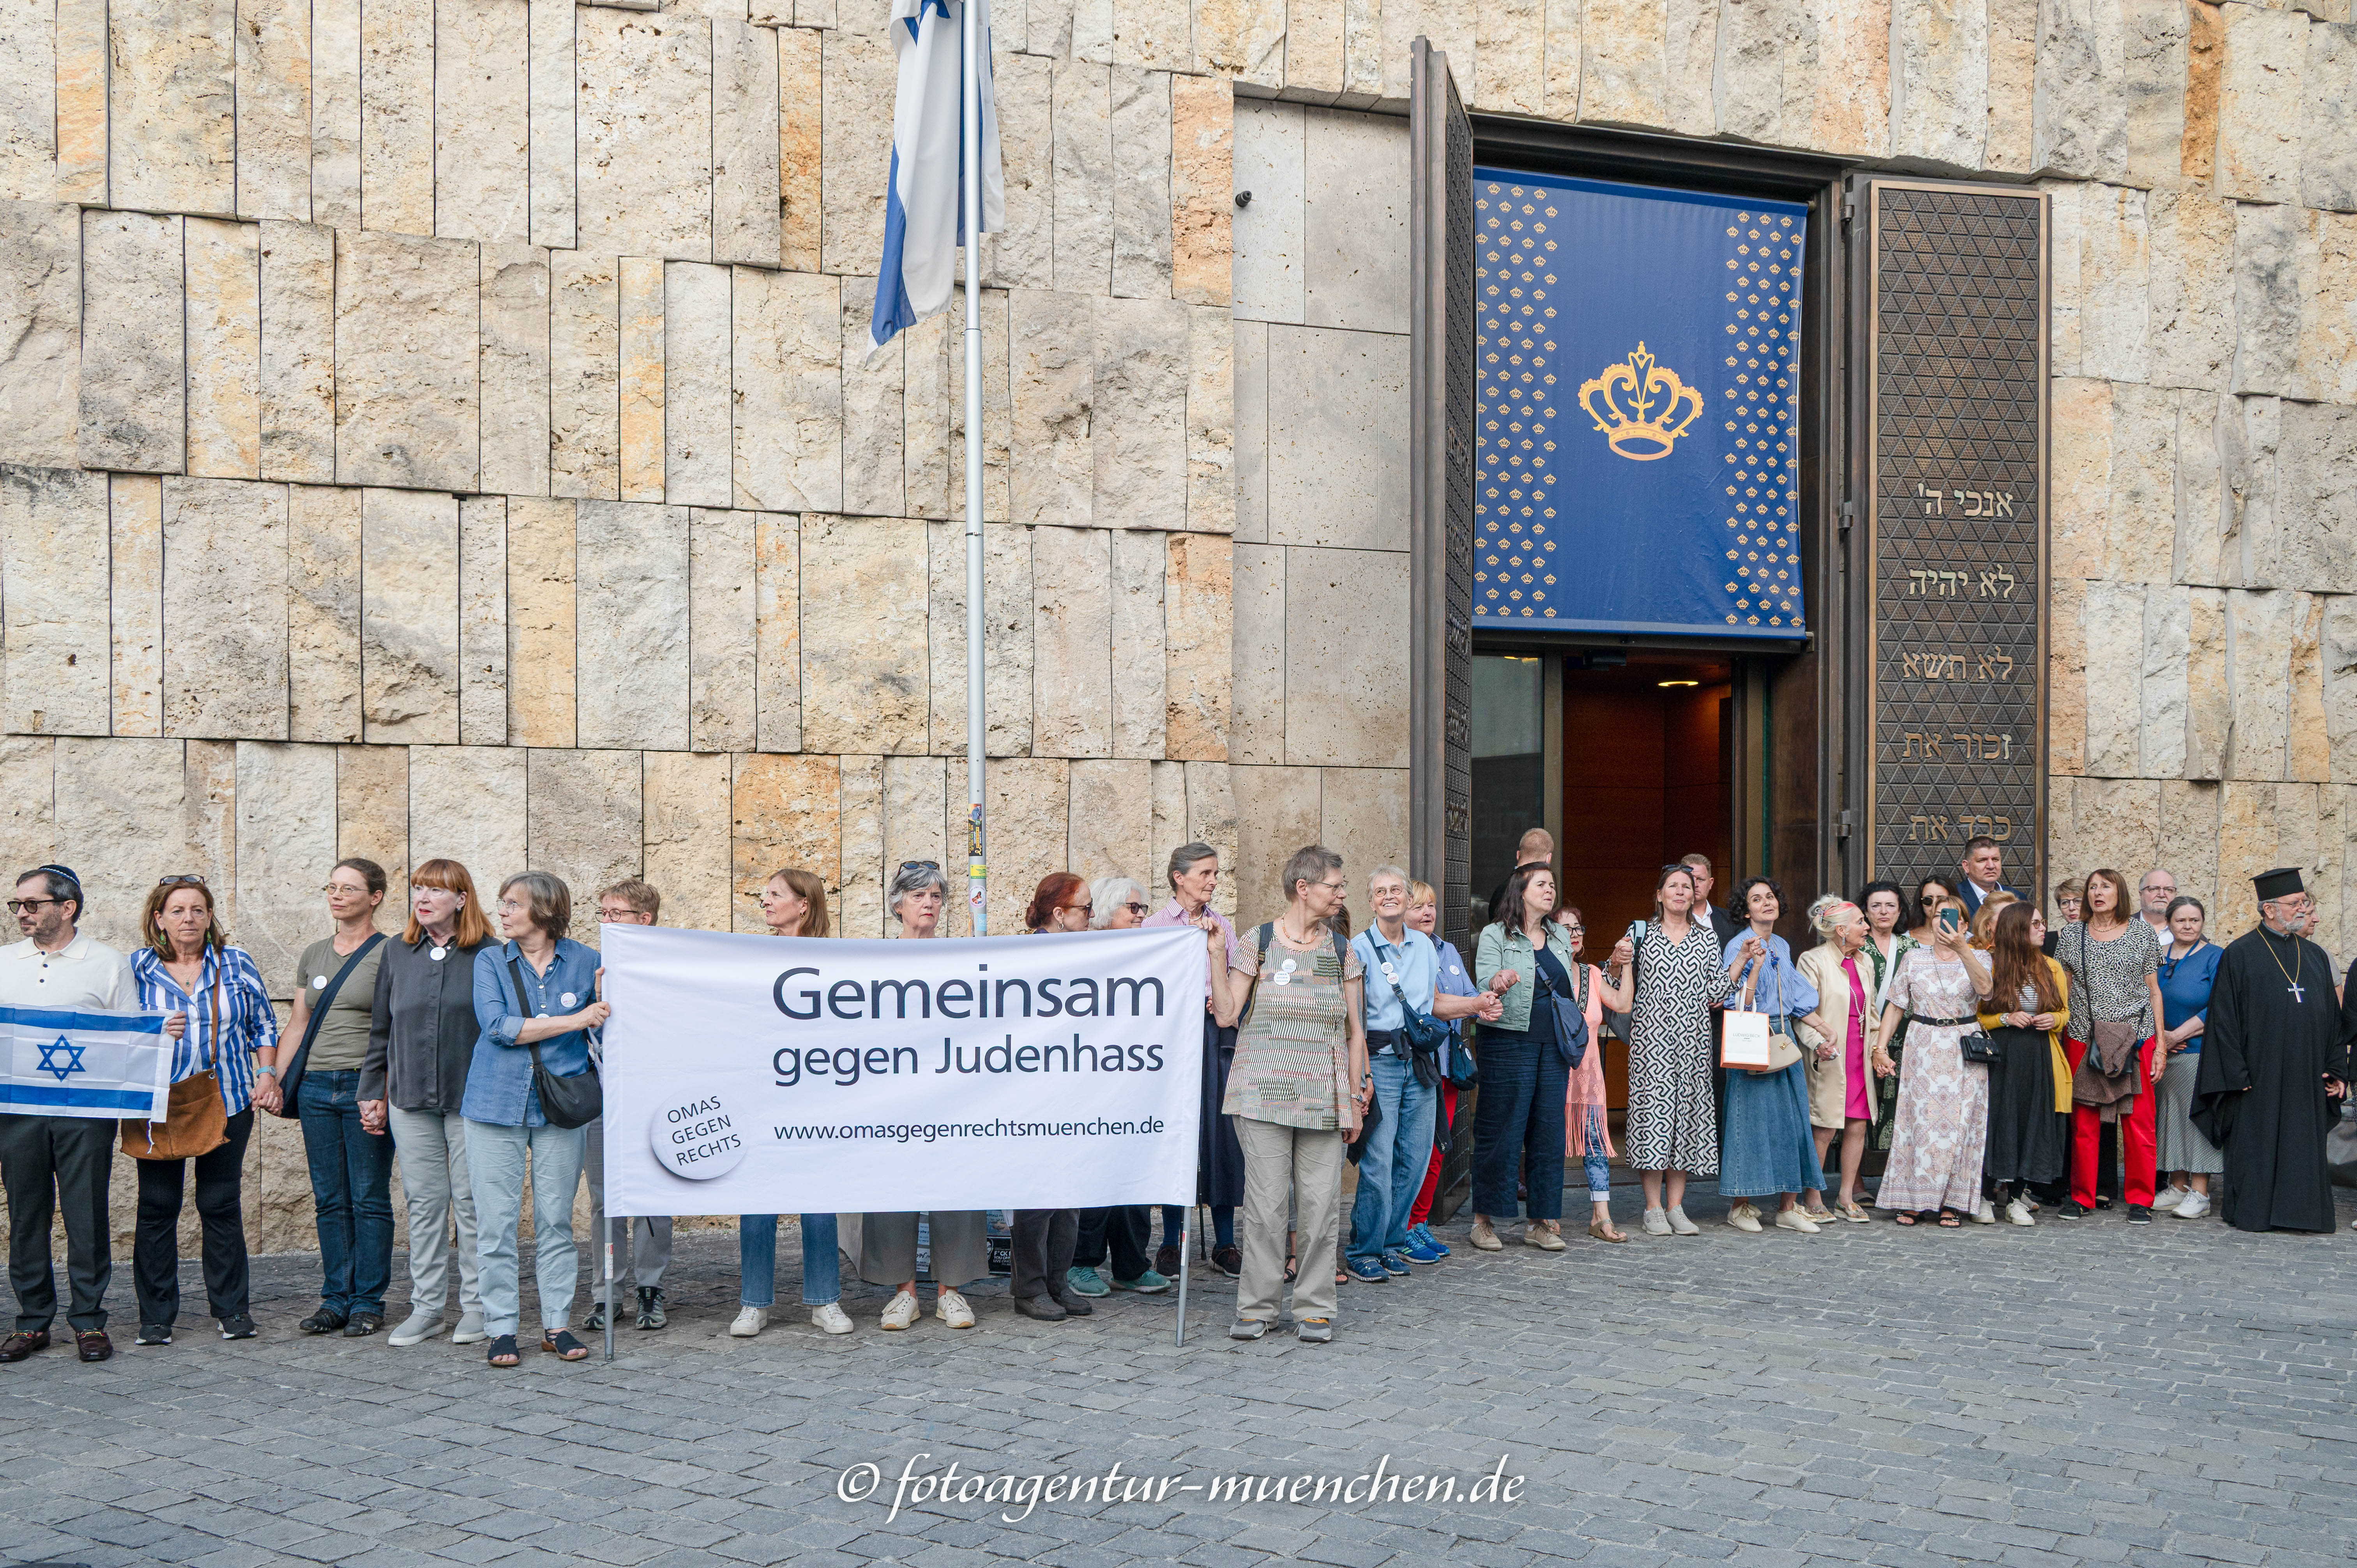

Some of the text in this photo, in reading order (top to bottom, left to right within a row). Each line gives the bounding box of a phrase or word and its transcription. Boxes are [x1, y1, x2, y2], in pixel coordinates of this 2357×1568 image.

[1954, 489, 2013, 517] אנכי
[1910, 564, 2014, 599] לא יהיה
[1903, 646, 2013, 680] לא תשא
[1903, 733, 2012, 759] זכור את
[1909, 815, 2011, 841] כבד את
[773, 964, 1164, 1020] Gemeinsam
[773, 1033, 1163, 1087] gegen Judenhass
[668, 1096, 721, 1123] OMAS
[672, 1114, 731, 1144] GEGEN
[774, 1116, 1164, 1143] www.omasgegenrechtsmuenchen.de
[676, 1134, 741, 1166] RECHTS
